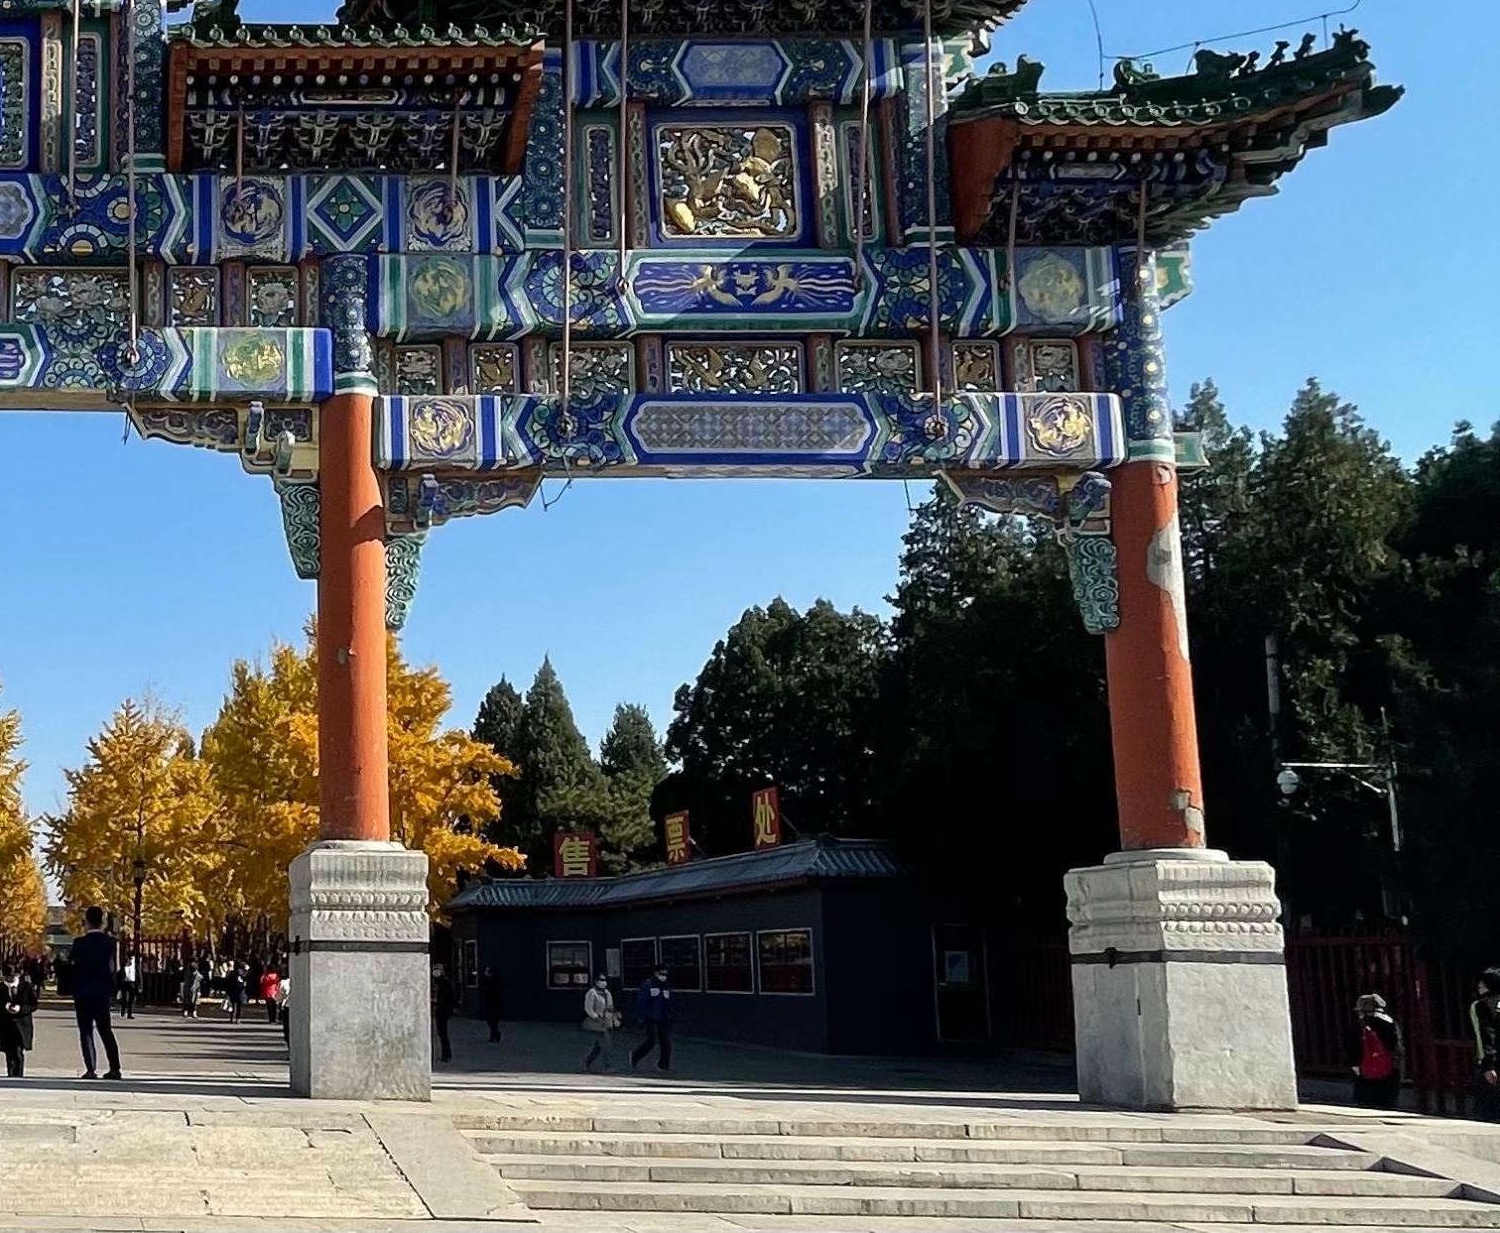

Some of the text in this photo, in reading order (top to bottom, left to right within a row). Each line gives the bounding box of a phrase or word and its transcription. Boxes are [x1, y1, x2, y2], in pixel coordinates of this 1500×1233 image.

[559, 792, 777, 877] 售 票 处
